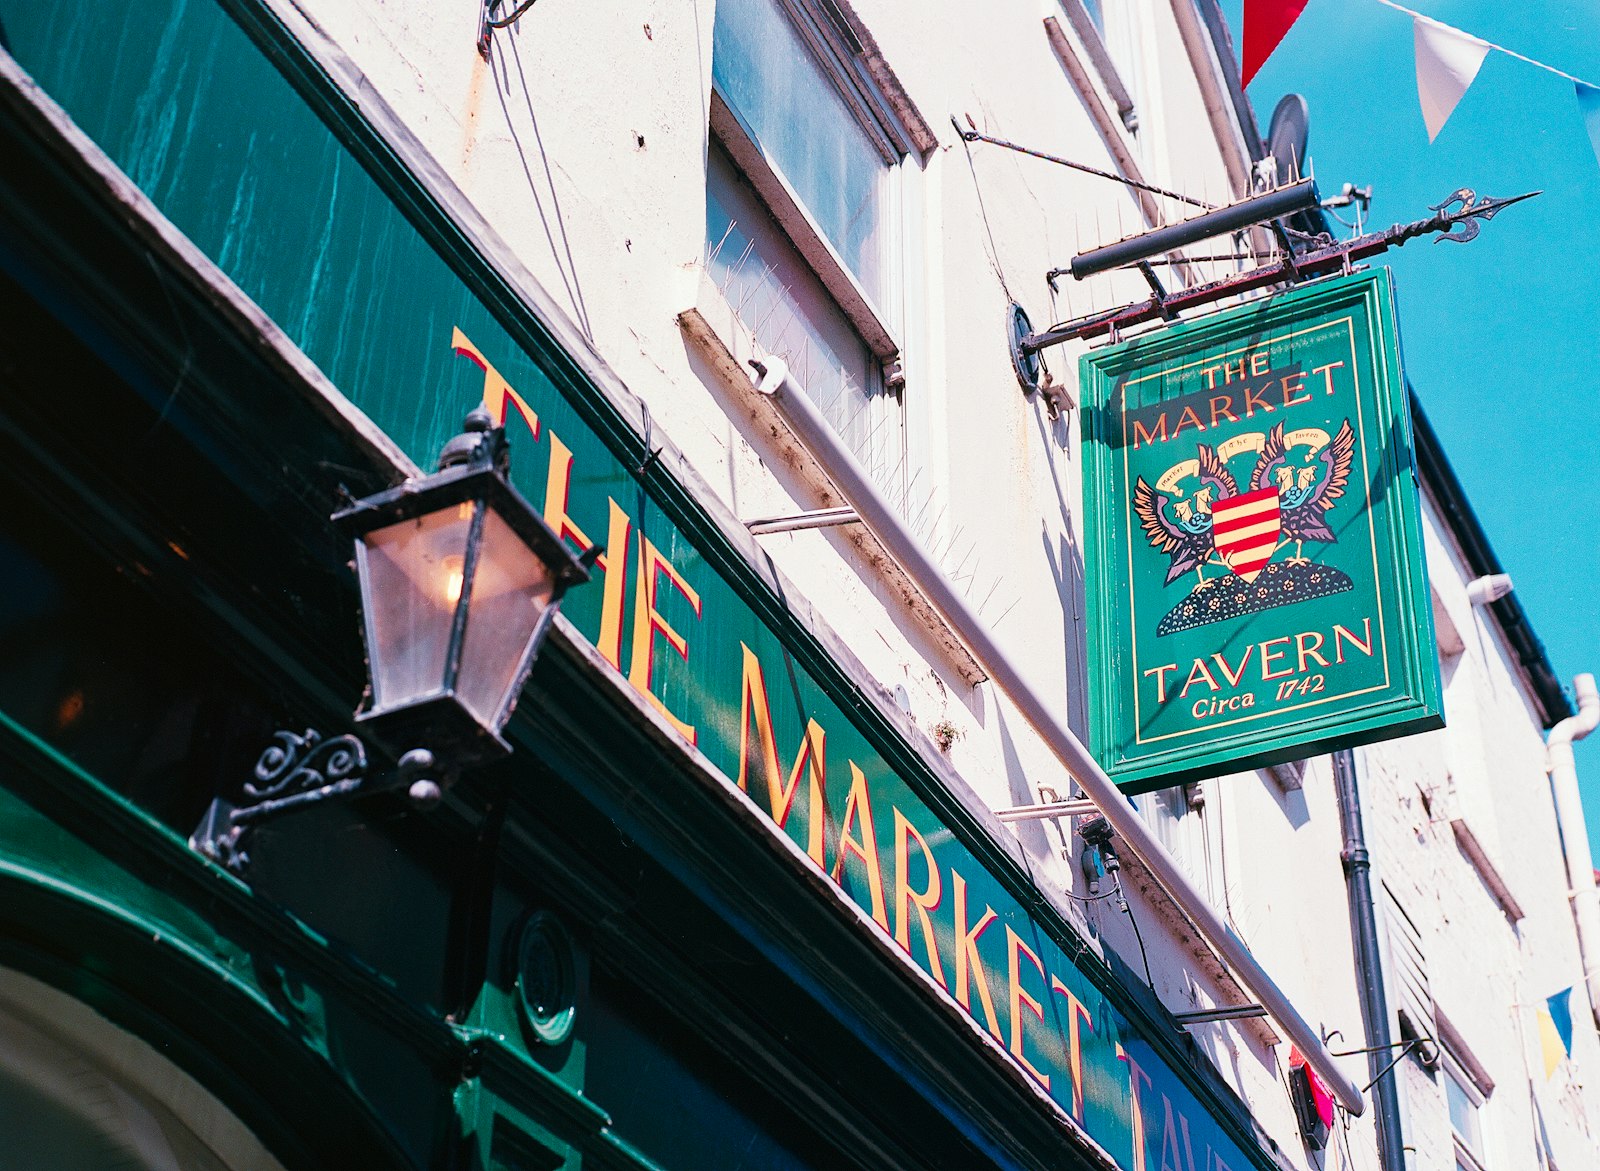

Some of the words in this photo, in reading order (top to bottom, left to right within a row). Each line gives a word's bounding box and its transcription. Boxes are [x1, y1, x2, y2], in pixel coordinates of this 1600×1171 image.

[1132, 361, 1345, 450] MARKET
[1202, 351, 1271, 390] THE
[1143, 617, 1373, 704] TAVERN
[1191, 692, 1255, 719] Circa
[1275, 674, 1325, 701] 1742
[451, 325, 702, 746] THE
[737, 640, 1093, 1126] MARKET
